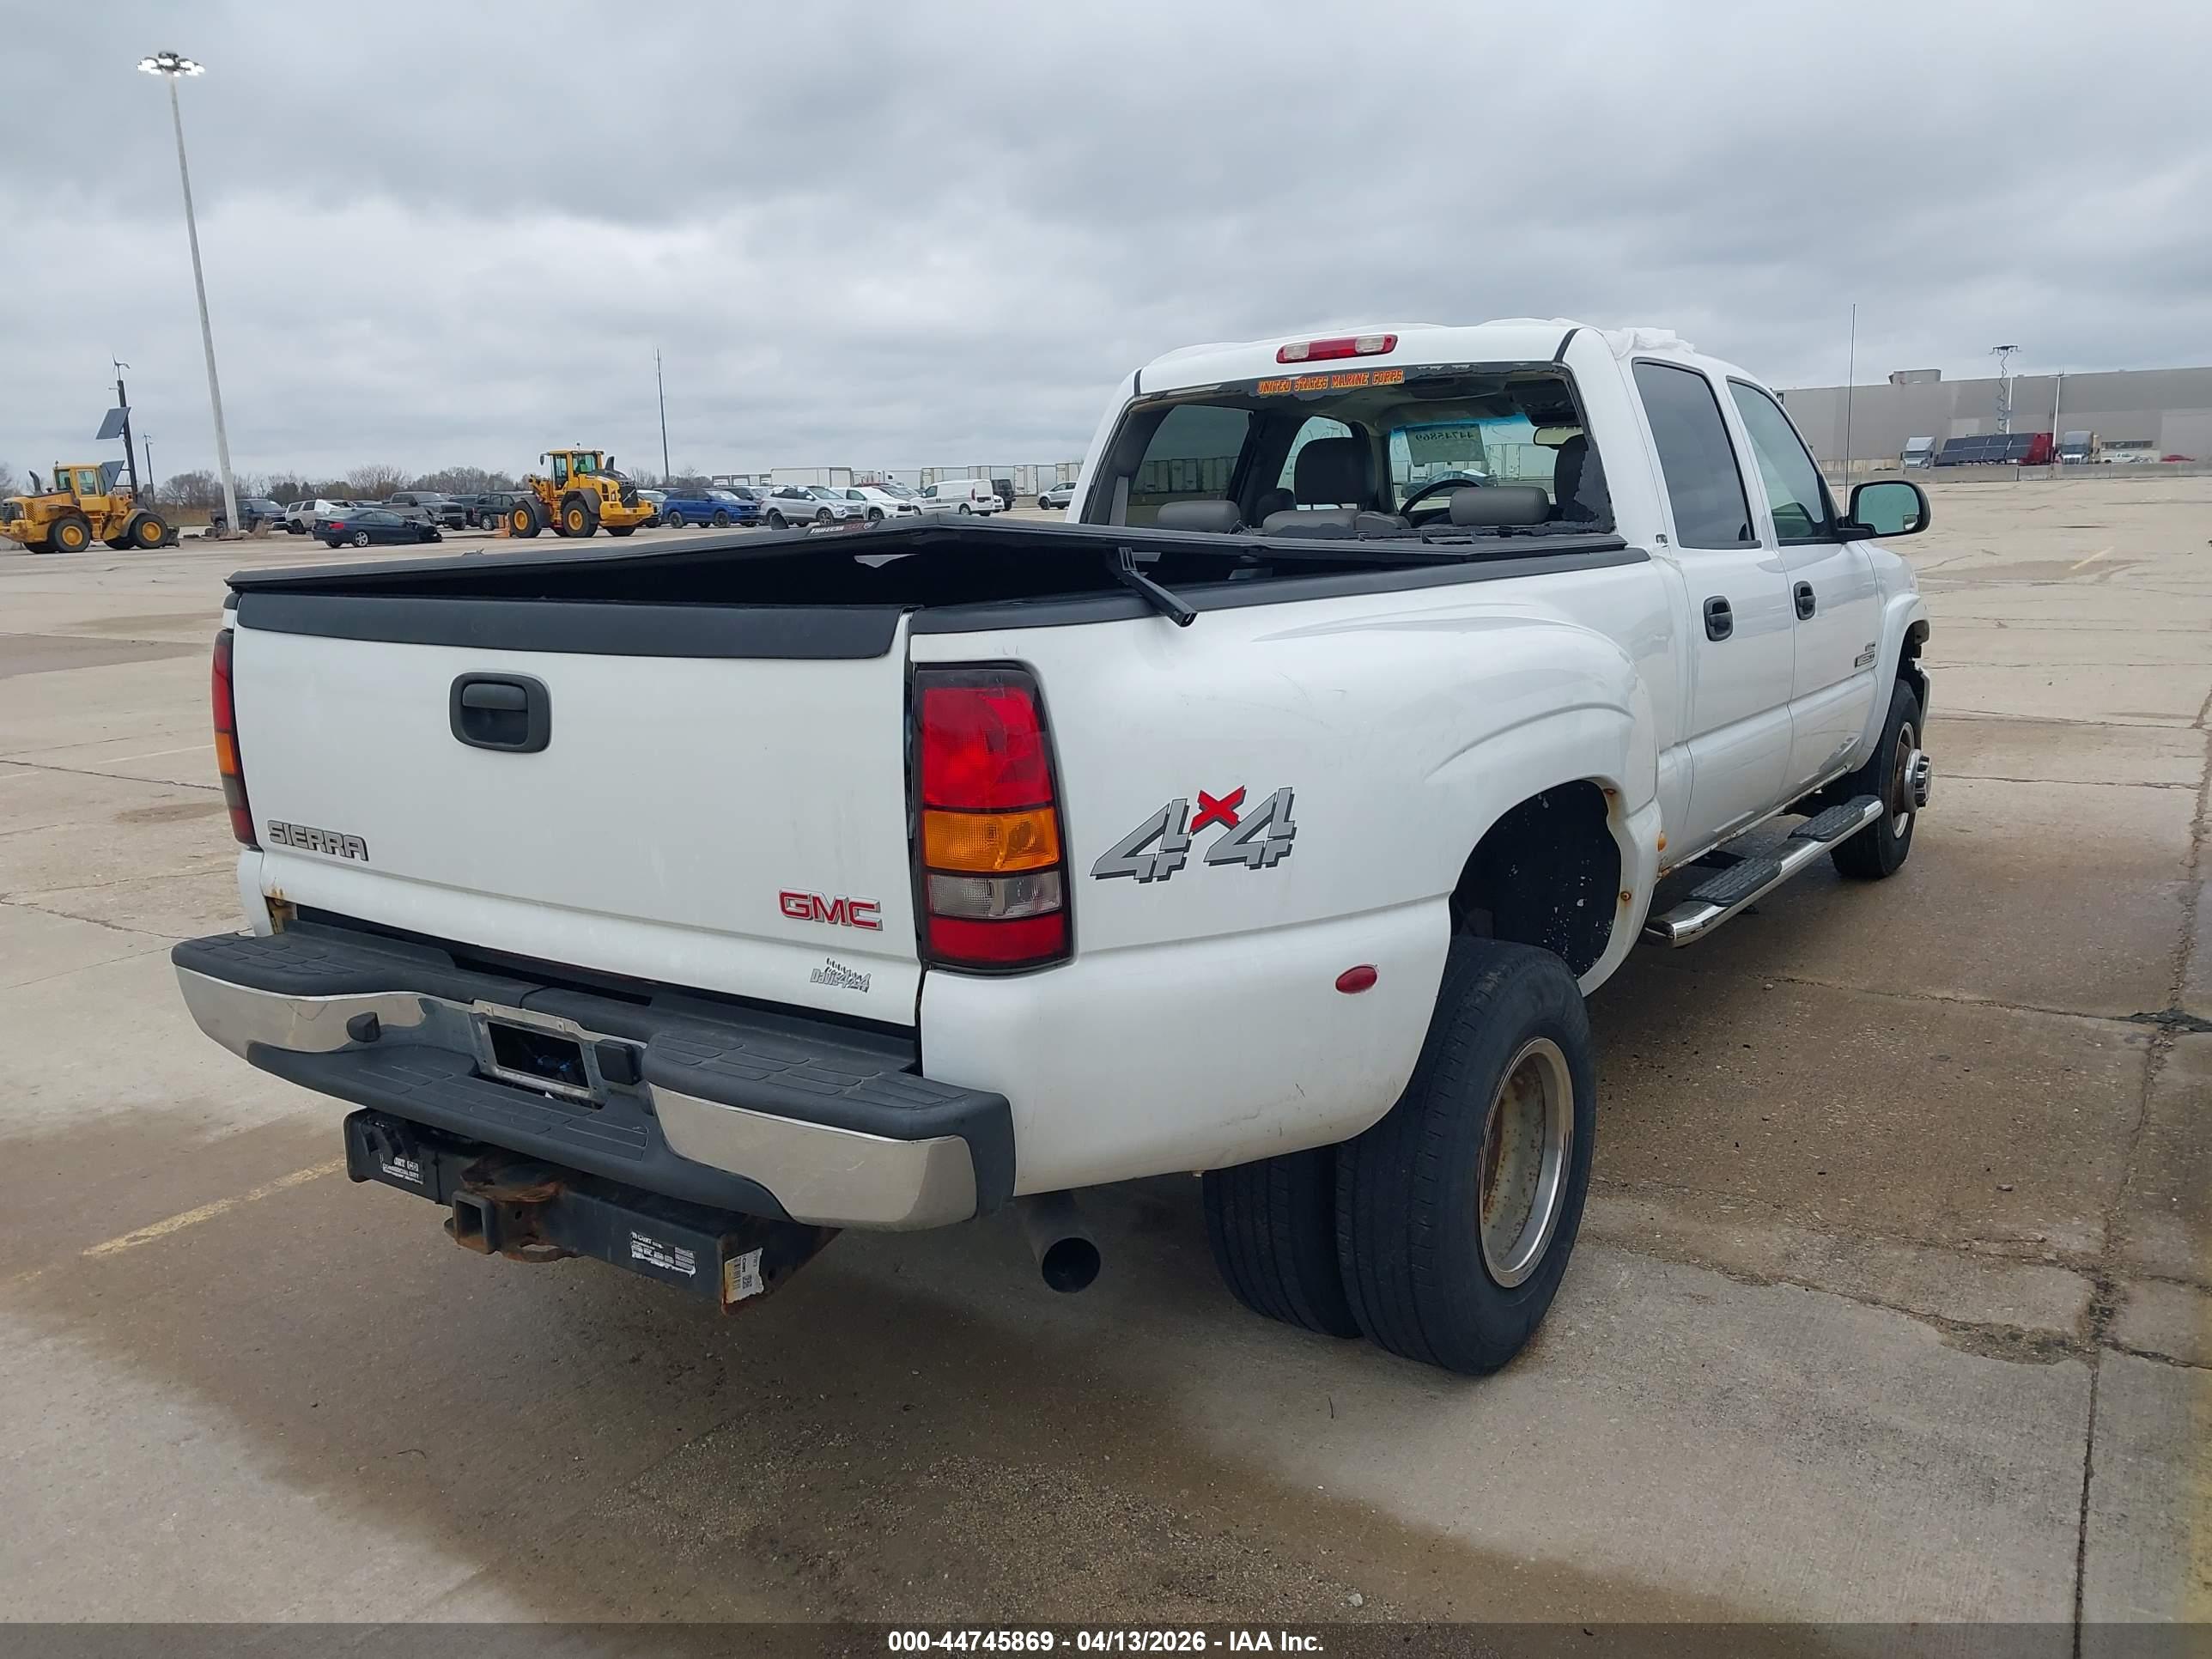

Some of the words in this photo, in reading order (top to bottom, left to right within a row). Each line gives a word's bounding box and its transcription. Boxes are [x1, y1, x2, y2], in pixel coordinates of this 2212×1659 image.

[1258, 380, 1291, 394] UNITED
[1293, 376, 1328, 392] STATES
[1332, 373, 1370, 388] MARINE
[1372, 369, 1405, 386] CORPS
[267, 820, 369, 861] SIERRA
[779, 888, 883, 931] GMC
